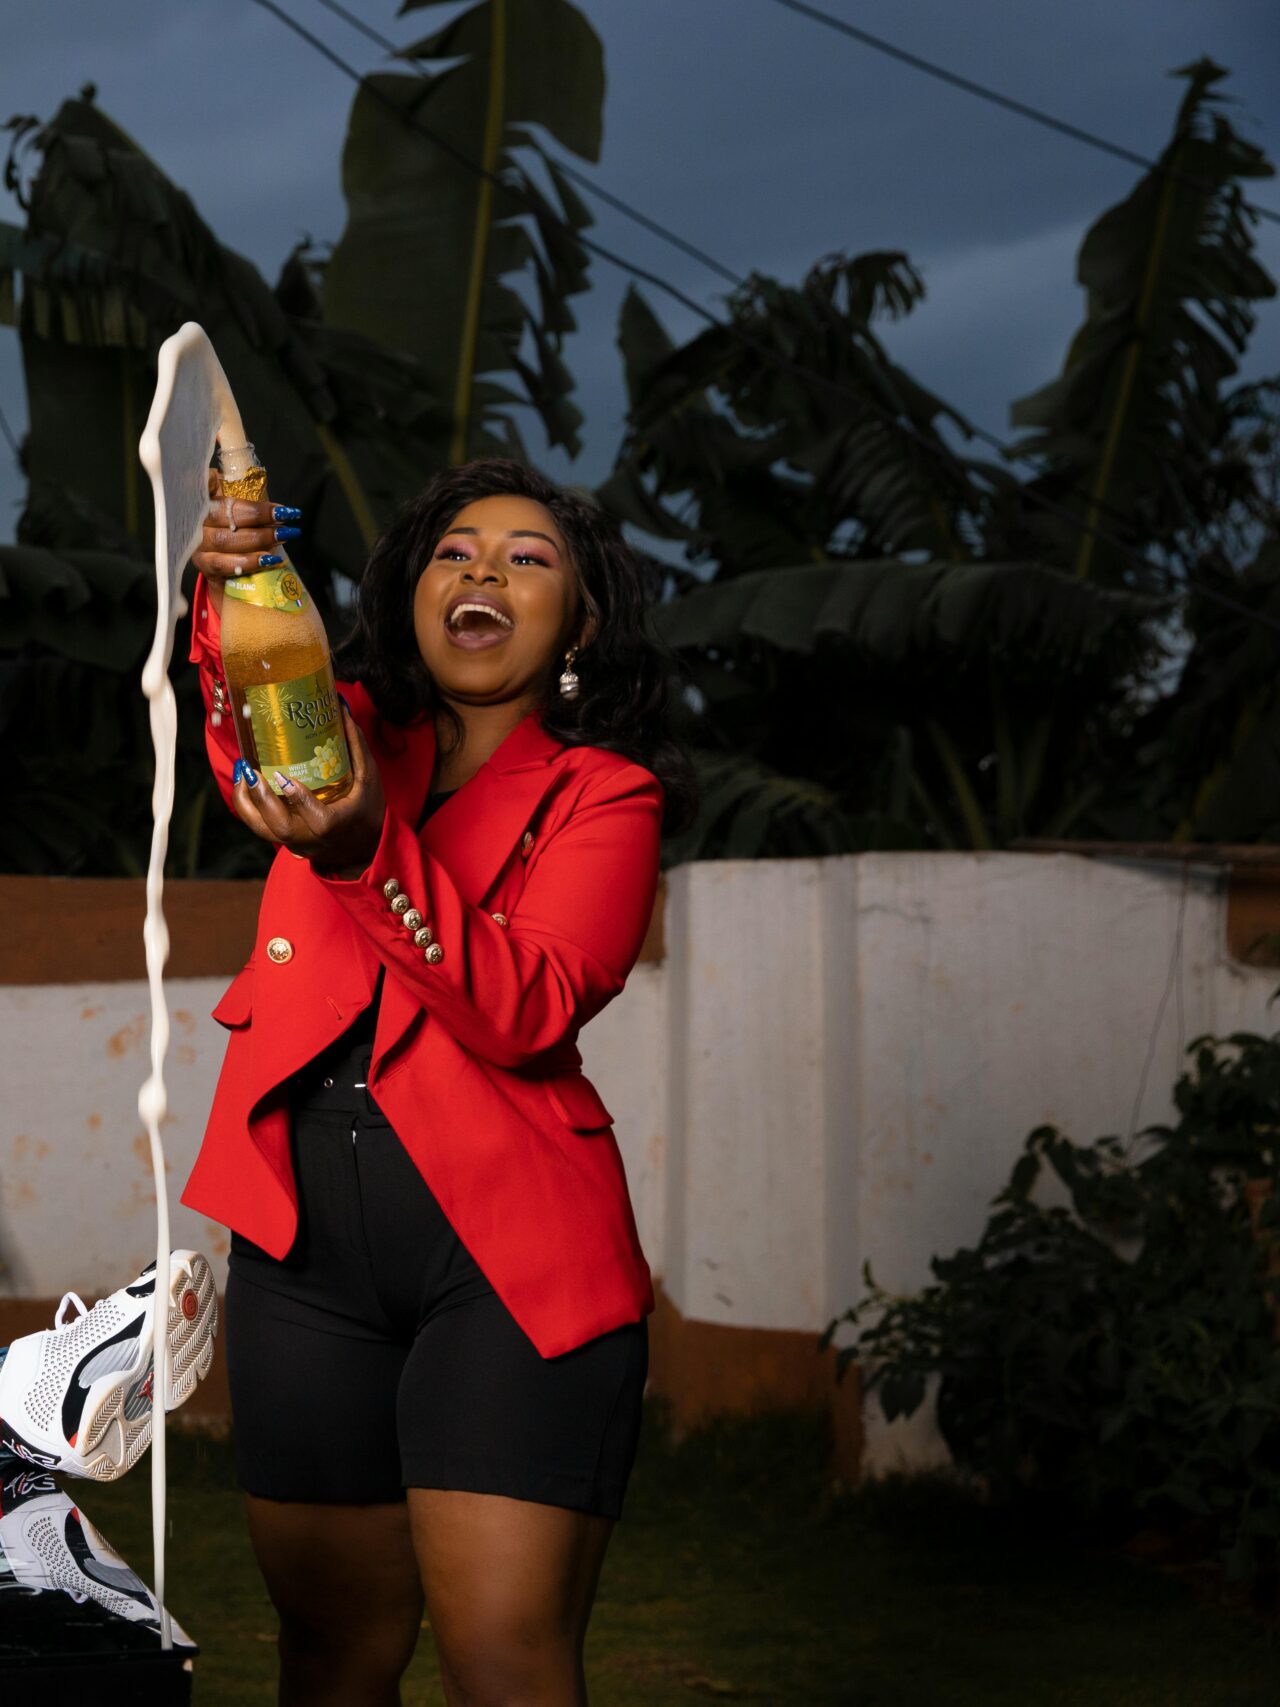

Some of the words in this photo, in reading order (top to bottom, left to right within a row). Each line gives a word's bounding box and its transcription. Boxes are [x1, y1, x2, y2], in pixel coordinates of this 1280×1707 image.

[236, 582, 256, 591] BLANC
[288, 764, 306, 772] WHITE
[289, 768, 308, 778] GRAPE
